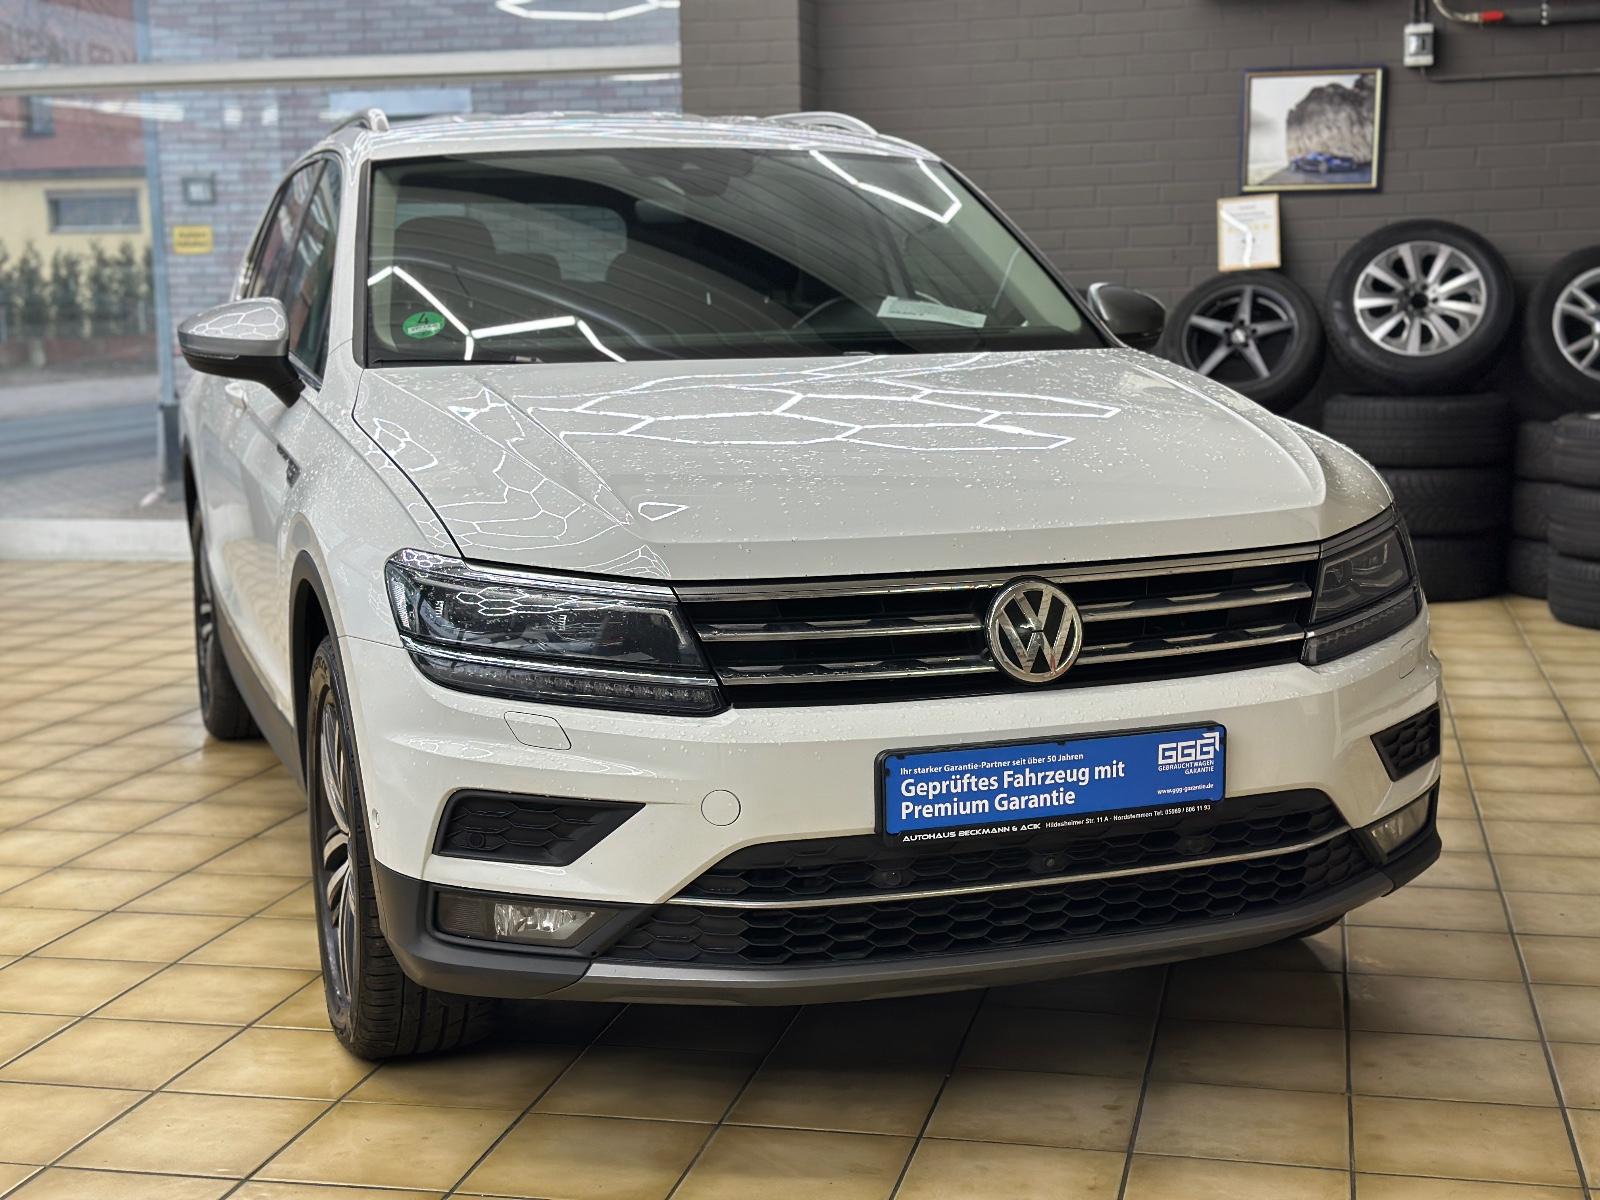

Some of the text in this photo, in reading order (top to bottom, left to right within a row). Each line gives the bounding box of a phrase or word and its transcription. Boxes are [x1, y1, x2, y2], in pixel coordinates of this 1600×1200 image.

[992, 583, 1078, 678] VW
[900, 752, 1084, 775] Ihr starker Garantie-Partner seit über 50 Jahren
[1158, 739, 1214, 764] GGG
[1158, 760, 1215, 772] GEBRAUCHTWAGEN
[1185, 766, 1215, 775] GARANTIE
[901, 760, 1126, 799] Geprüftes Fahrzeug mit
[1157, 783, 1214, 794] www.ggg-garantie.de
[901, 787, 1076, 820] Premium Garantie
[903, 831, 956, 842] AUTOHAUS
[958, 826, 1010, 836] BECKMANN
[1045, 819, 1085, 828] Hildesheimer
[1113, 811, 1153, 821] Nordstemmen
